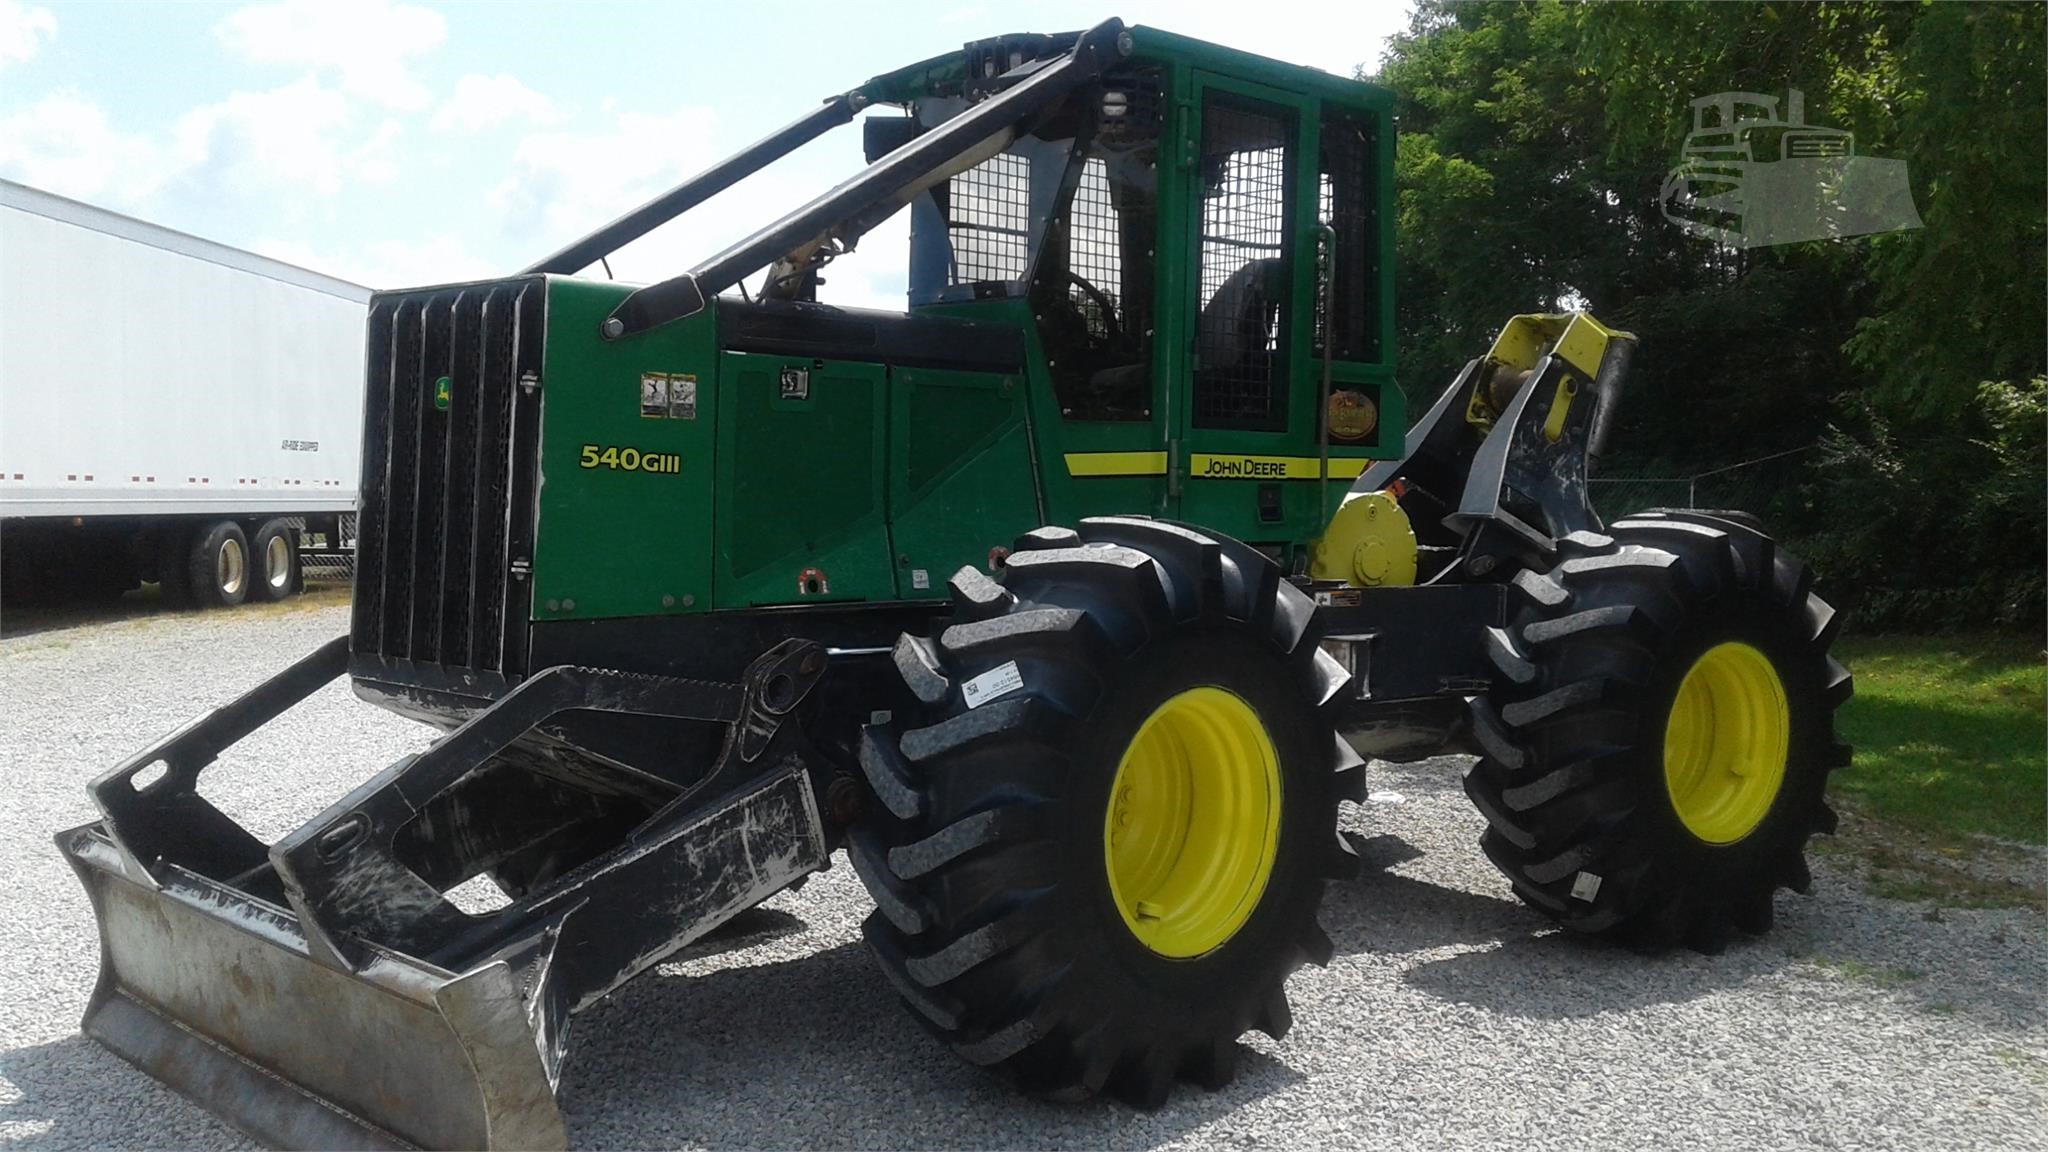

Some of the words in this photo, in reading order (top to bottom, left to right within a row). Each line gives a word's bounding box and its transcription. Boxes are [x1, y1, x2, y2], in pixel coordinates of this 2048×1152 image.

[580, 444, 680, 474] 540GIII
[1204, 458, 1241, 475] JOHN
[1244, 459, 1286, 476] DEERE
